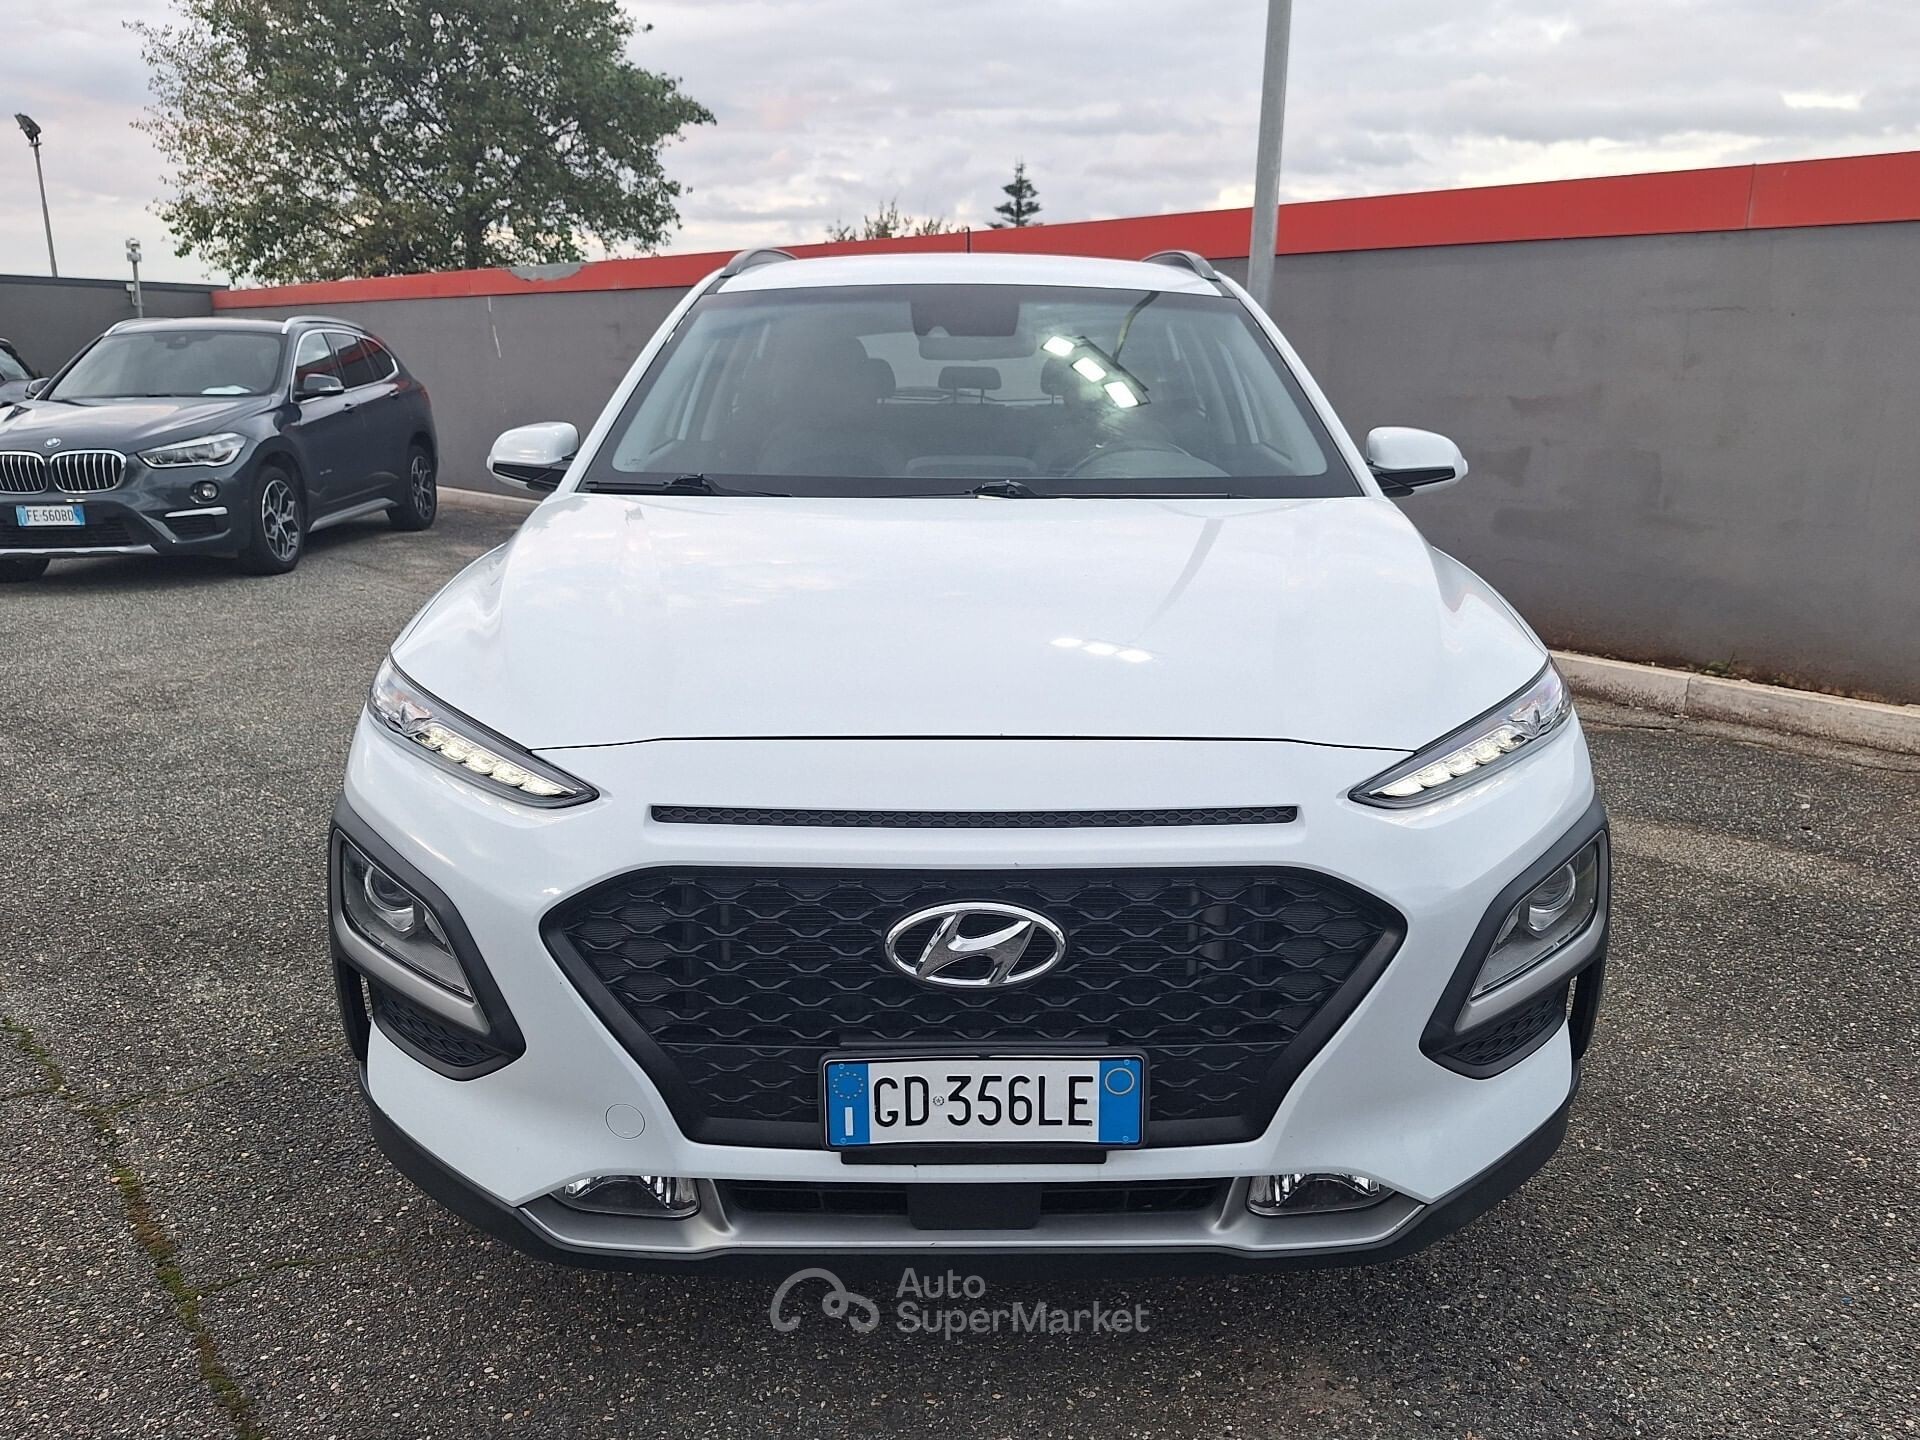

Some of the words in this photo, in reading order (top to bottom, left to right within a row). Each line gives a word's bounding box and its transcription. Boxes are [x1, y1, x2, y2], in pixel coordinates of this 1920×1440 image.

[26, 509, 40, 521] FE
[873, 1076, 930, 1127] GD
[946, 1075, 1094, 1126] 356LE
